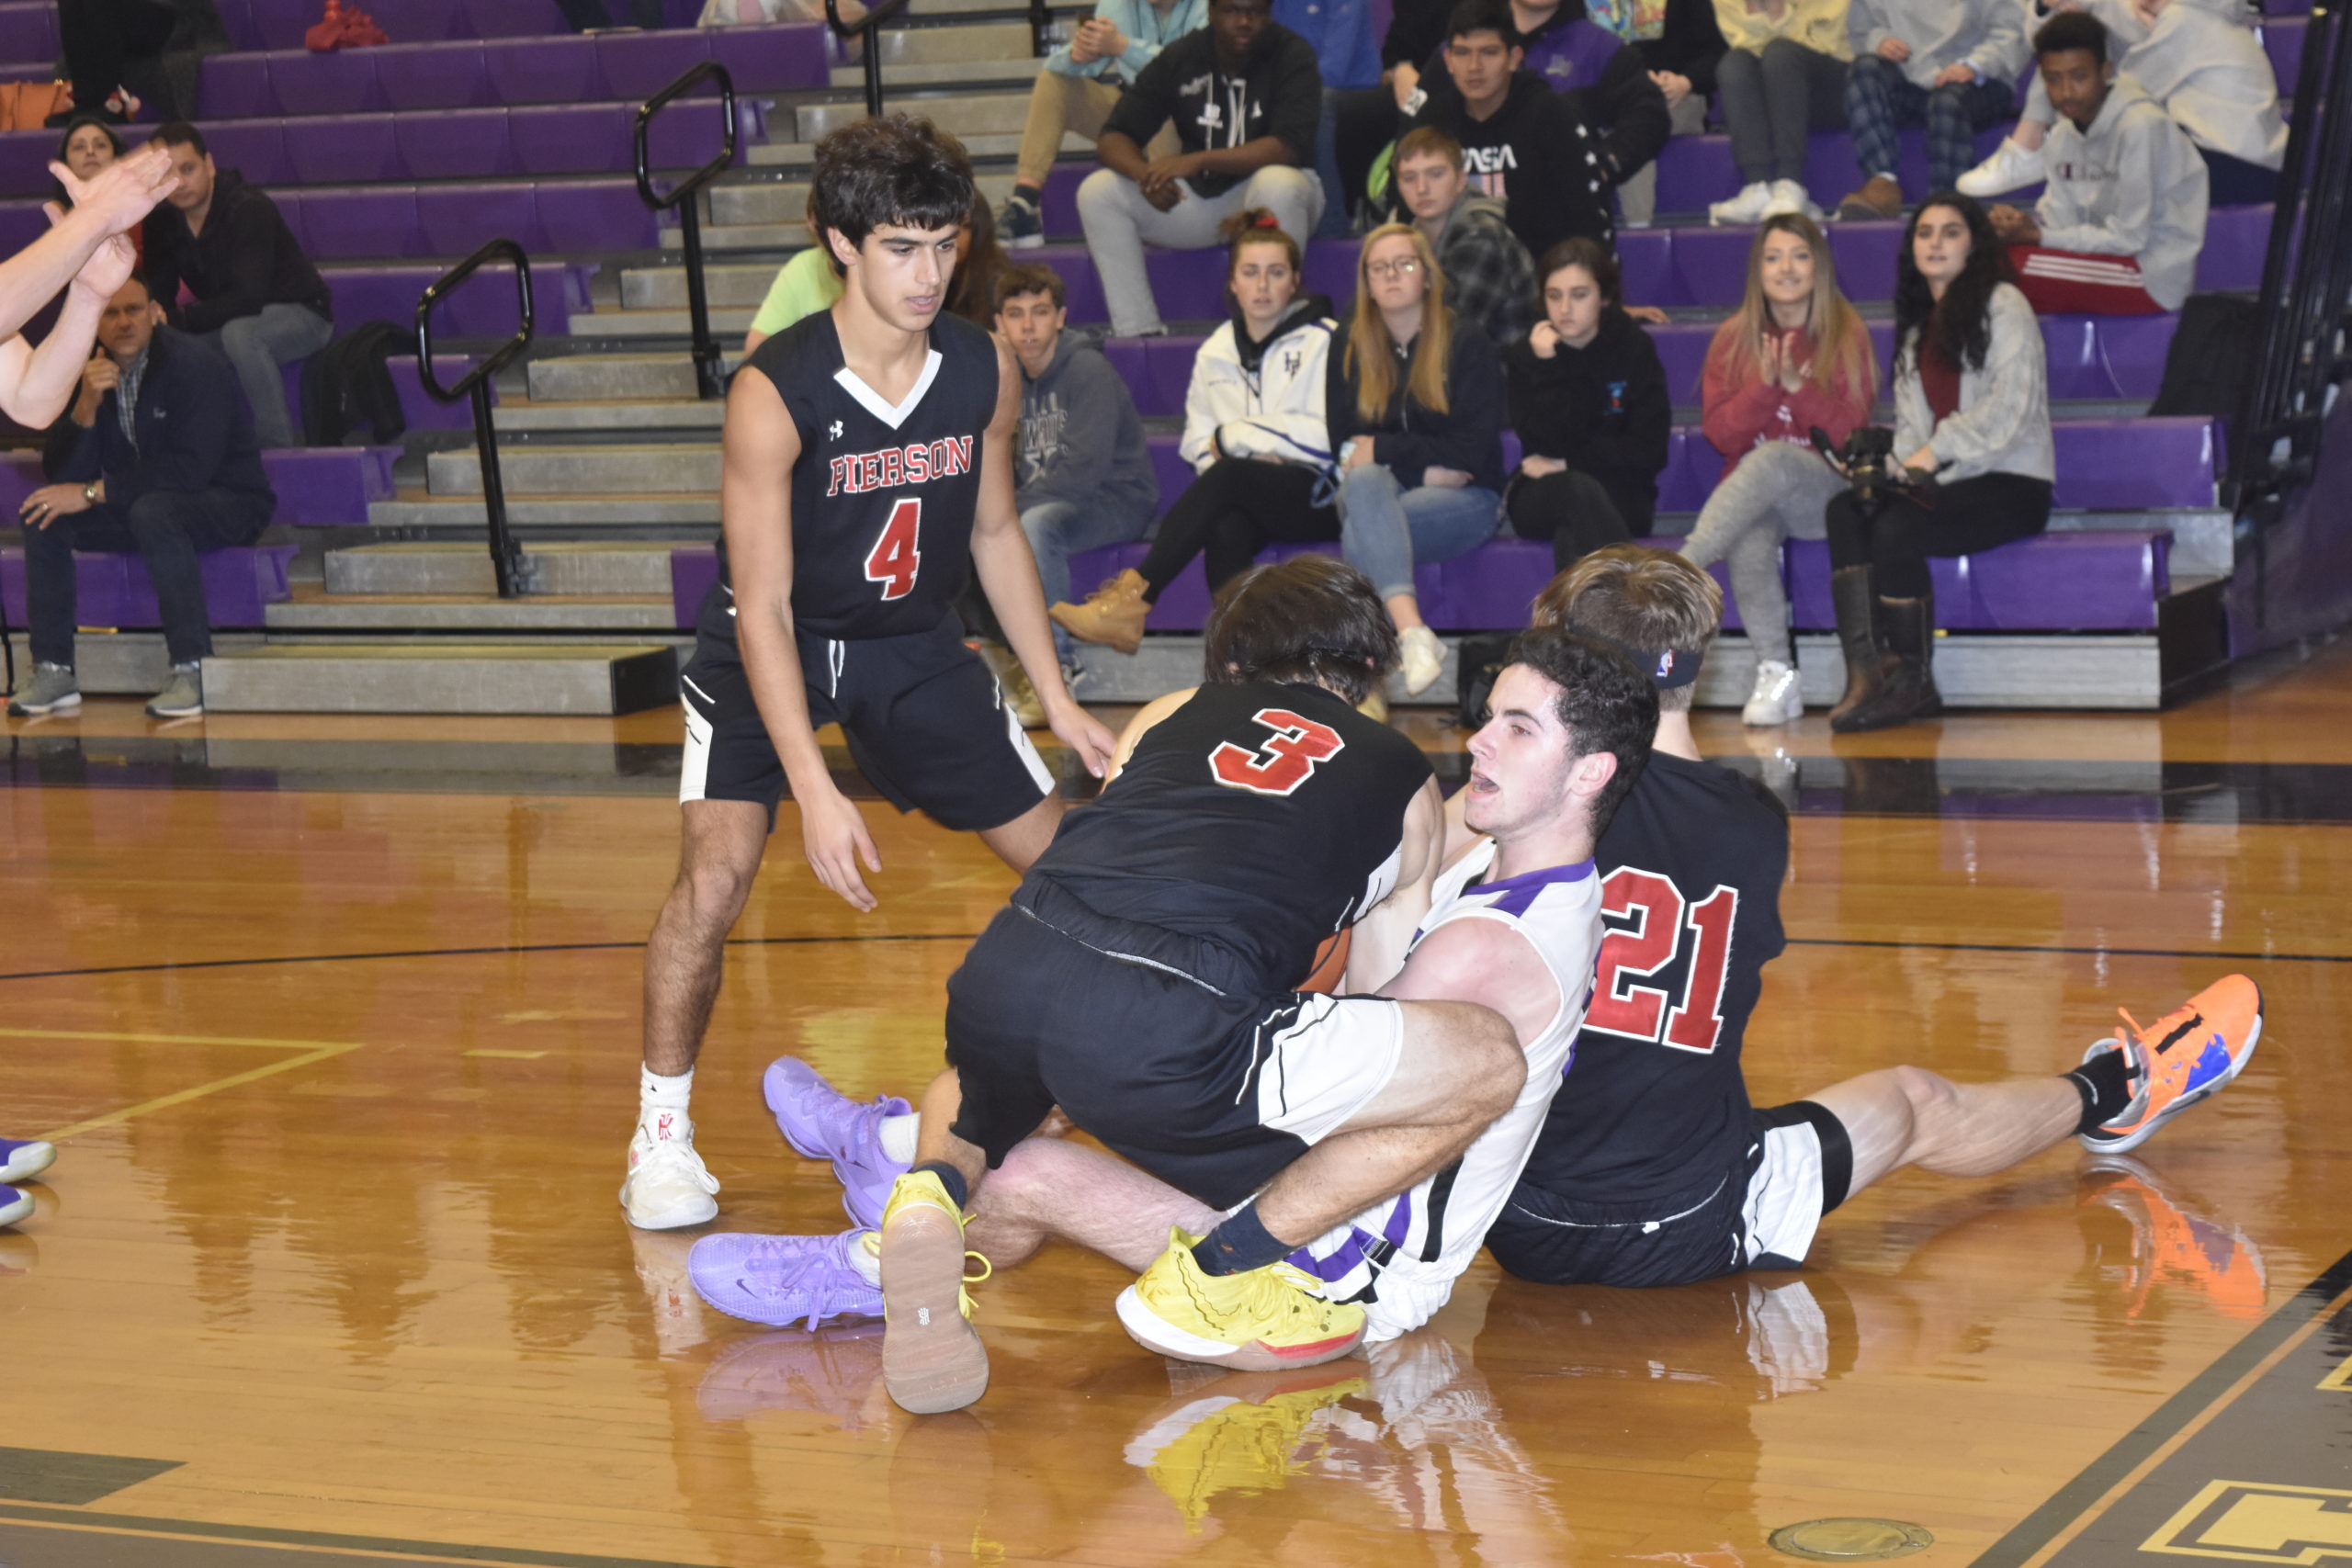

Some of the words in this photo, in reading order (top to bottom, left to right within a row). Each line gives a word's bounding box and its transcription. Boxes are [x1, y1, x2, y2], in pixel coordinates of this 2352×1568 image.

[1460, 143, 1519, 174] ASA
[827, 435, 973, 497] PIERSON
[865, 498, 922, 601] 4
[1208, 708, 1345, 795] 3
[1580, 865, 1738, 1054] 21
